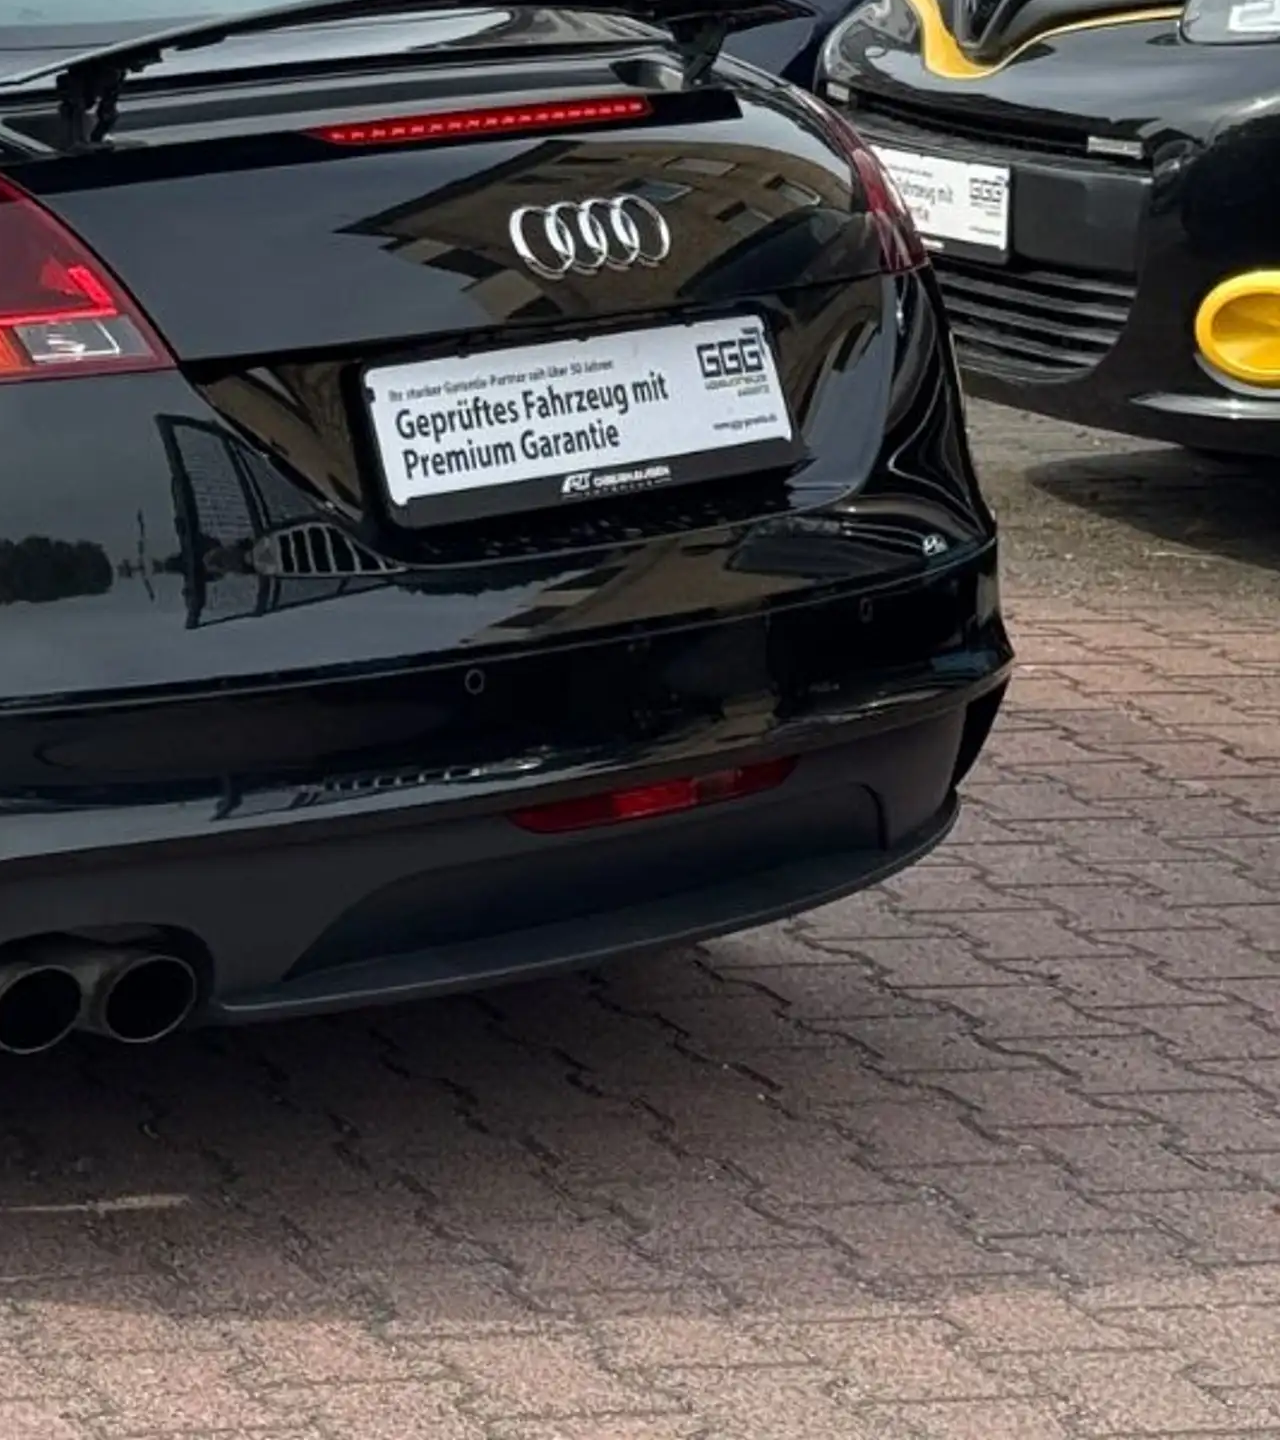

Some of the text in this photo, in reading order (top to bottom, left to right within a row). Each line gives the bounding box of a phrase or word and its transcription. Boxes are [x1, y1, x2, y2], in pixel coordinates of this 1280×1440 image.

[696, 336, 764, 378] GGG
[395, 396, 520, 443] Geprüftes
[522, 383, 630, 420] Fahrzeug
[631, 369, 669, 404] mit
[402, 419, 621, 480] Premium Garantie
